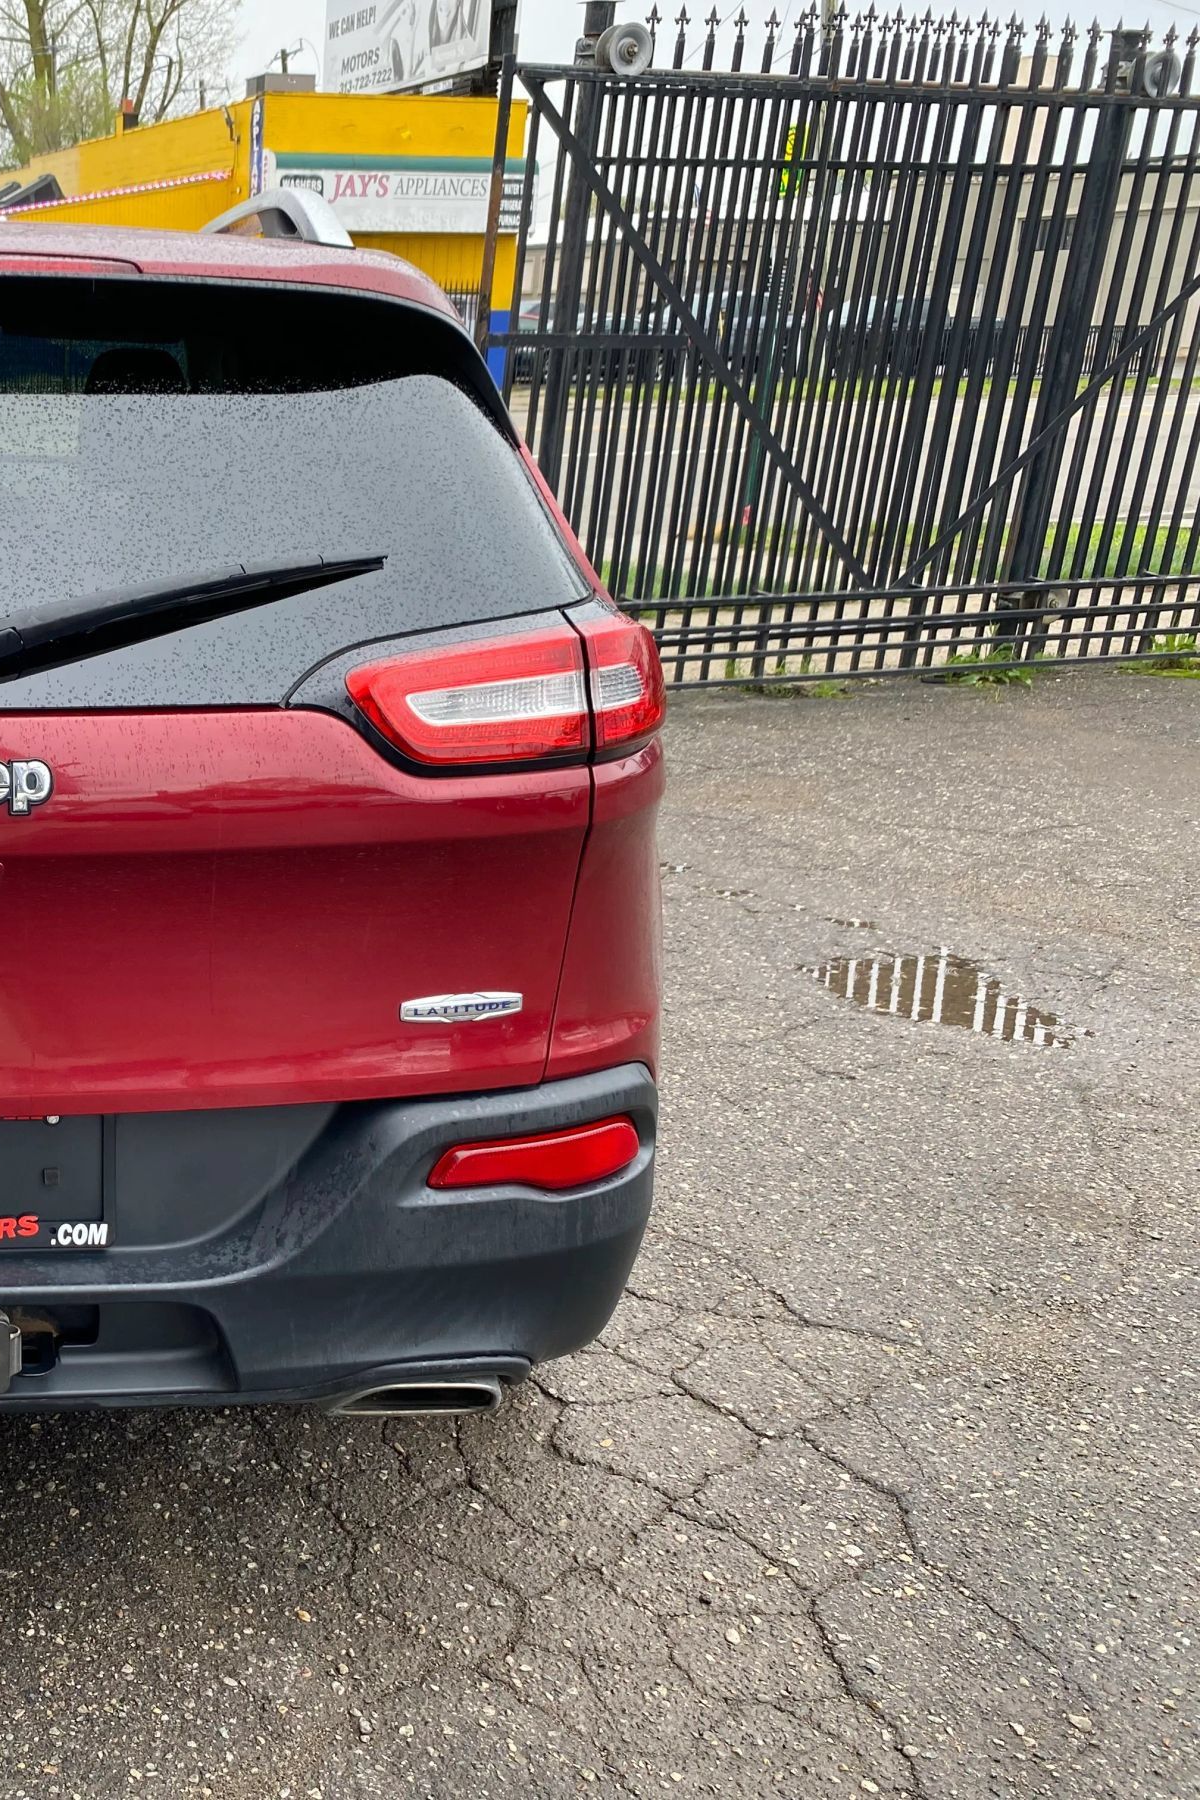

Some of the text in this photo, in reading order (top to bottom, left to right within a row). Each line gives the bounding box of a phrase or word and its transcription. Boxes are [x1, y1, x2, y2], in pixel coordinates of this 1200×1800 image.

[329, 5, 377, 40] WE CAN HELP!
[341, 46, 380, 76] MOTORS
[281, 177, 322, 193] WASHERS
[328, 173, 390, 204] JAY'S
[394, 176, 489, 198] APPLIANCES
[413, 1000, 512, 1016] LATITUDE
